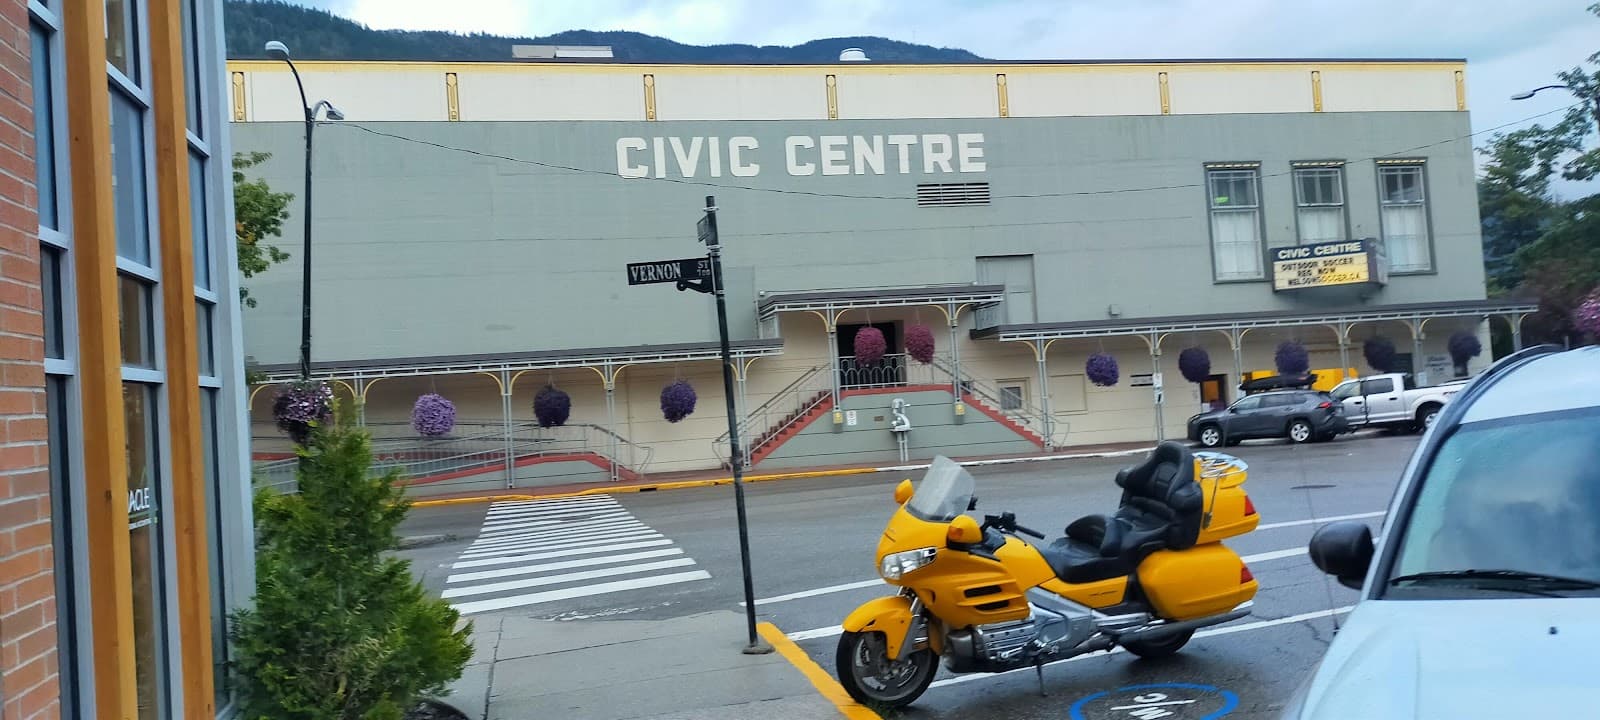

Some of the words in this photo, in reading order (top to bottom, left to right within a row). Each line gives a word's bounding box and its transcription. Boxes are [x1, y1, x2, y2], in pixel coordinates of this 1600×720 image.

[616, 136, 760, 179] CIVIC
[786, 132, 988, 176] CENTRE
[1279, 247, 1311, 260] CIVIC
[1314, 242, 1361, 256] CENTRE
[630, 262, 682, 281] VERNON
[697, 260, 709, 269] ST
[1281, 262, 1319, 271] OUTDOOR
[1323, 257, 1354, 267] SOCCER
[1318, 267, 1336, 275] NOW
